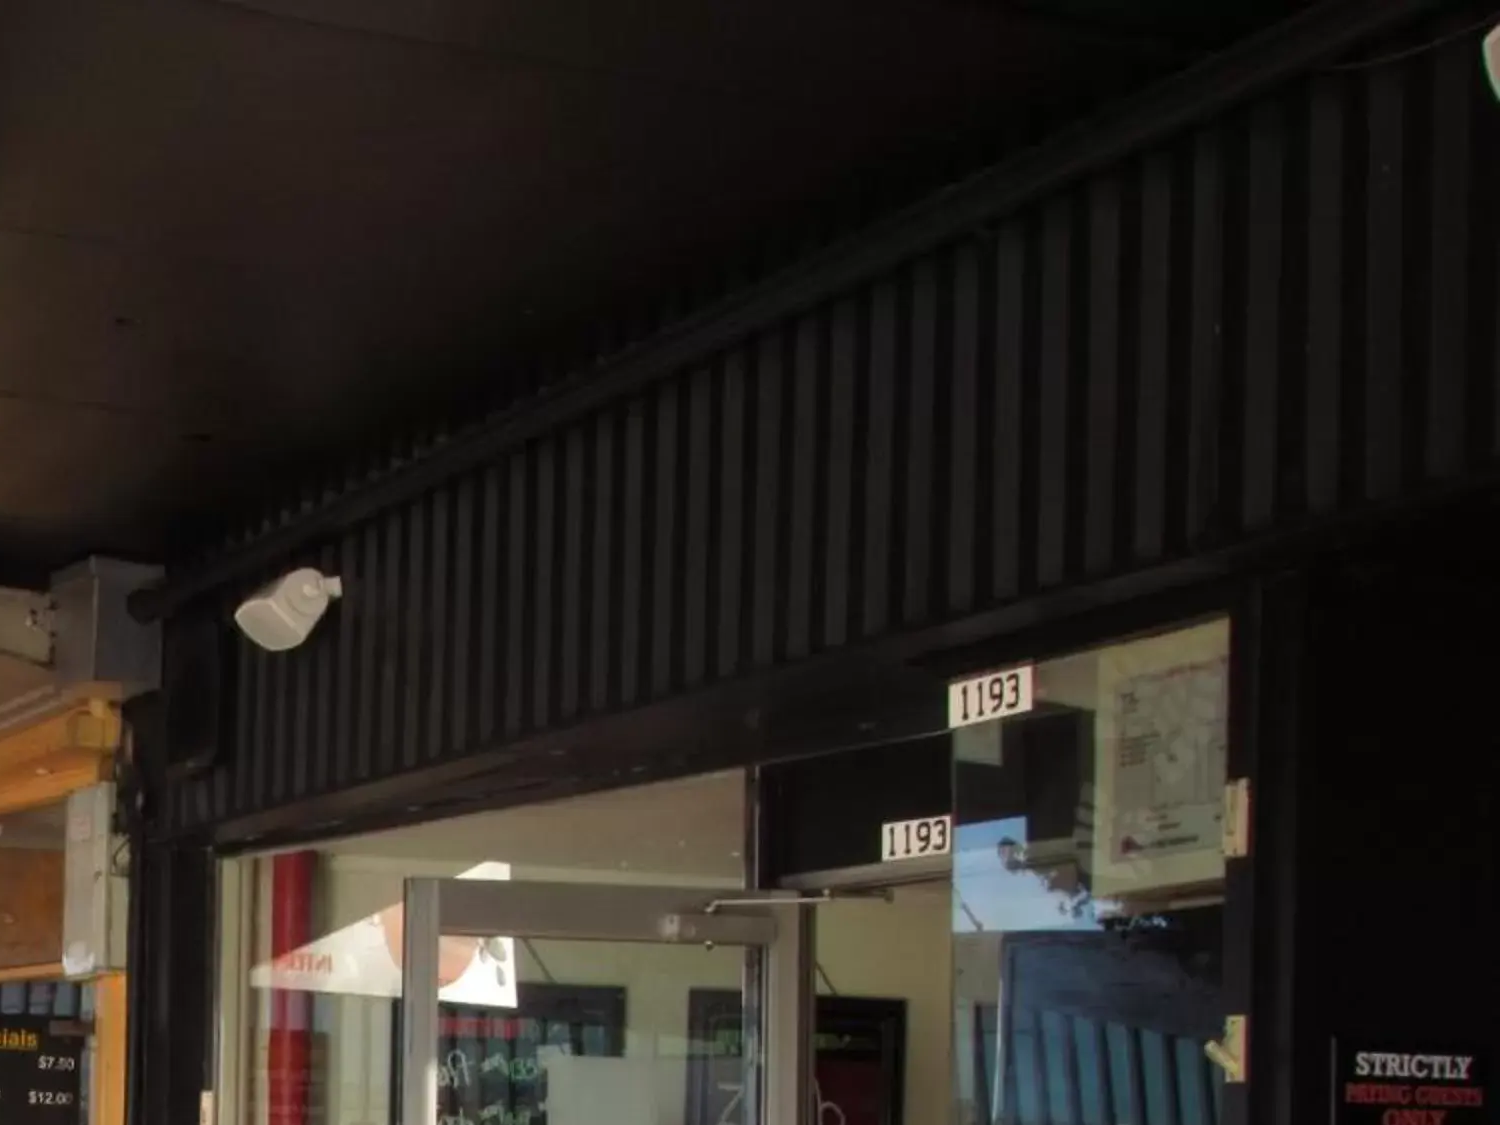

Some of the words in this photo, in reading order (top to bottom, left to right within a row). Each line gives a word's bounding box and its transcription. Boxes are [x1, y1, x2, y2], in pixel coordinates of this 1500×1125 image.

[961, 674, 1021, 721] 1193
[888, 819, 948, 857] 1193
[1355, 1051, 1474, 1080] STRICTLY
